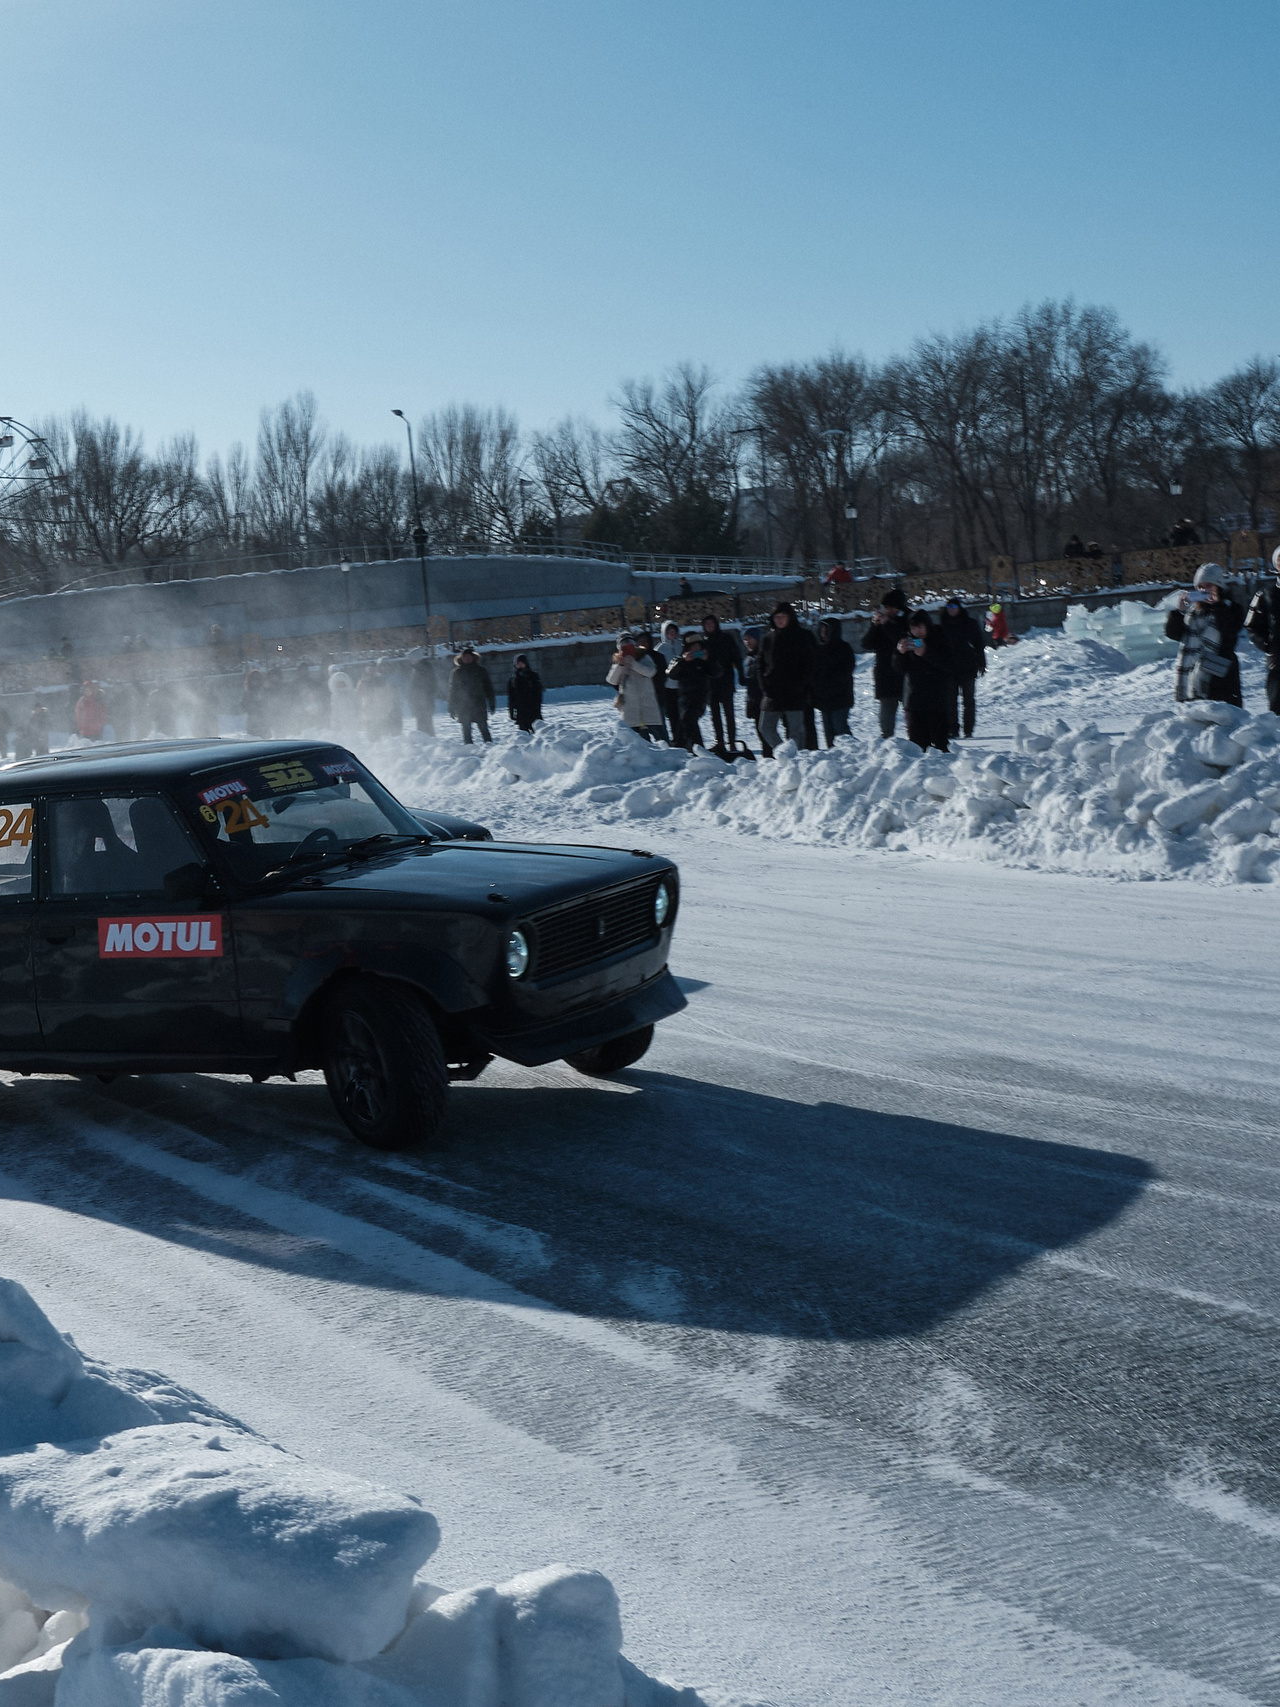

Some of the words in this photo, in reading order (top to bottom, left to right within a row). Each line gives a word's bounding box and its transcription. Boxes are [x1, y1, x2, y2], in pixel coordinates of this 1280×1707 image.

[202, 781, 247, 804] MOTUL
[215, 798, 269, 834] 24
[104, 921, 217, 952] MOTUL
